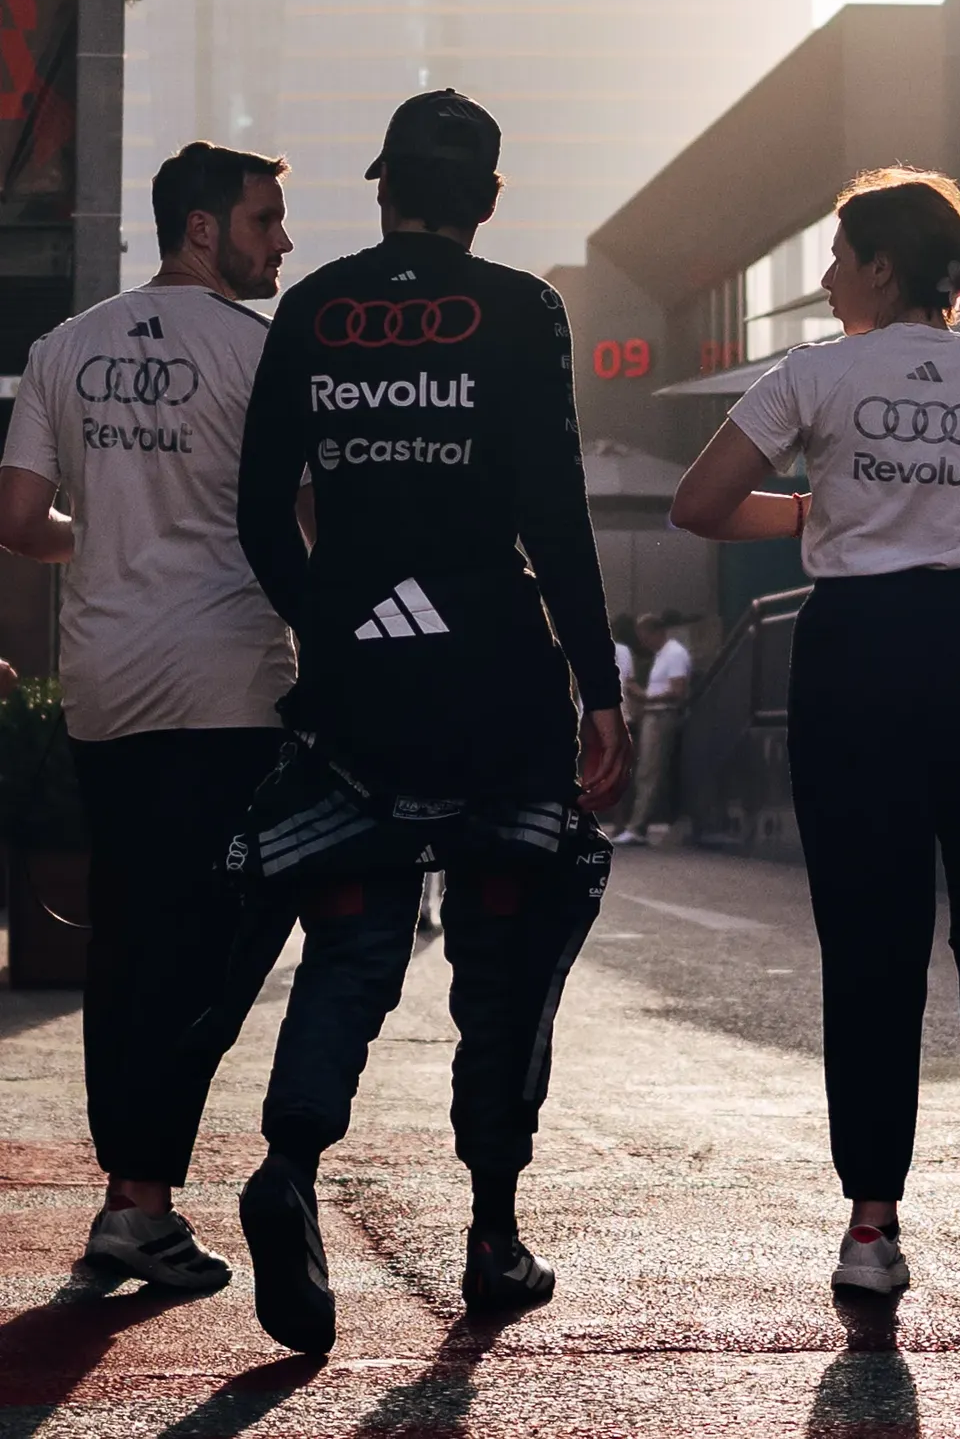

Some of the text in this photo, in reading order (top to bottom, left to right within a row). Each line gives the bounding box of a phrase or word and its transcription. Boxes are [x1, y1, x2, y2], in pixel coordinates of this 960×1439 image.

[592, 337, 651, 380] 09
[310, 372, 476, 412] Revolut
[82, 417, 193, 453] Revout
[344, 437, 472, 465] Castrol
